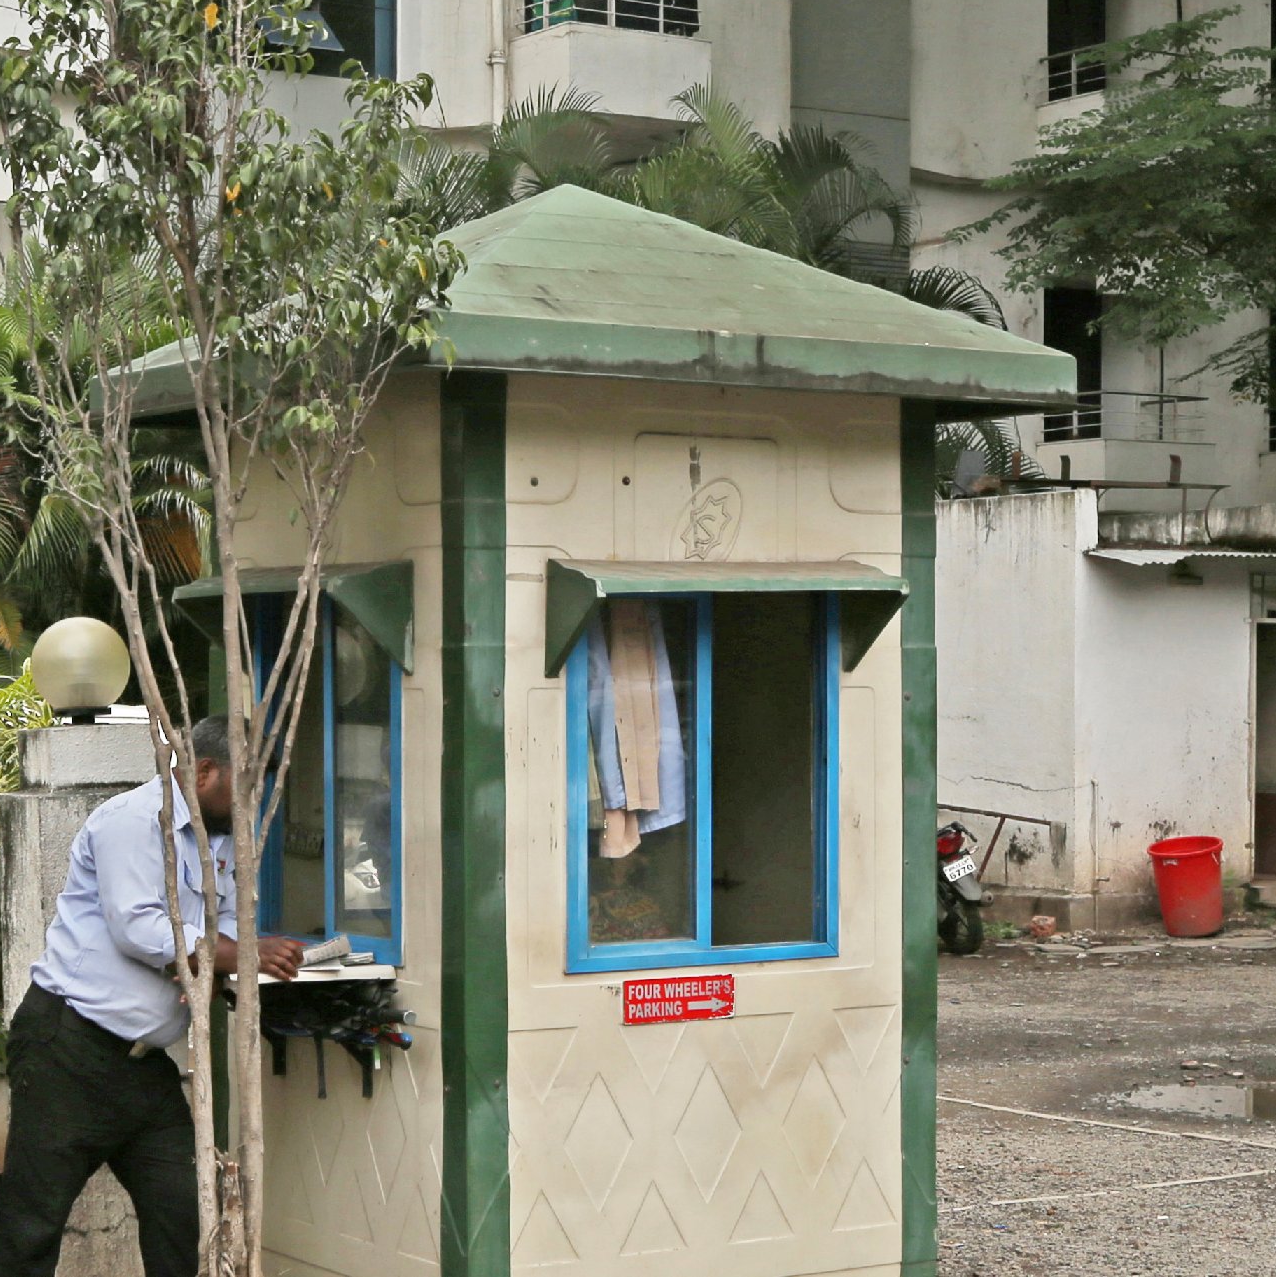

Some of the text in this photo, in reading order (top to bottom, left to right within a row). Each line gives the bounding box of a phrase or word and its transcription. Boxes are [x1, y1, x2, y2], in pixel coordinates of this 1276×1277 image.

[628, 980, 731, 1000] FOUR WHEELER'S
[628, 1001, 683, 1019] PARKING
